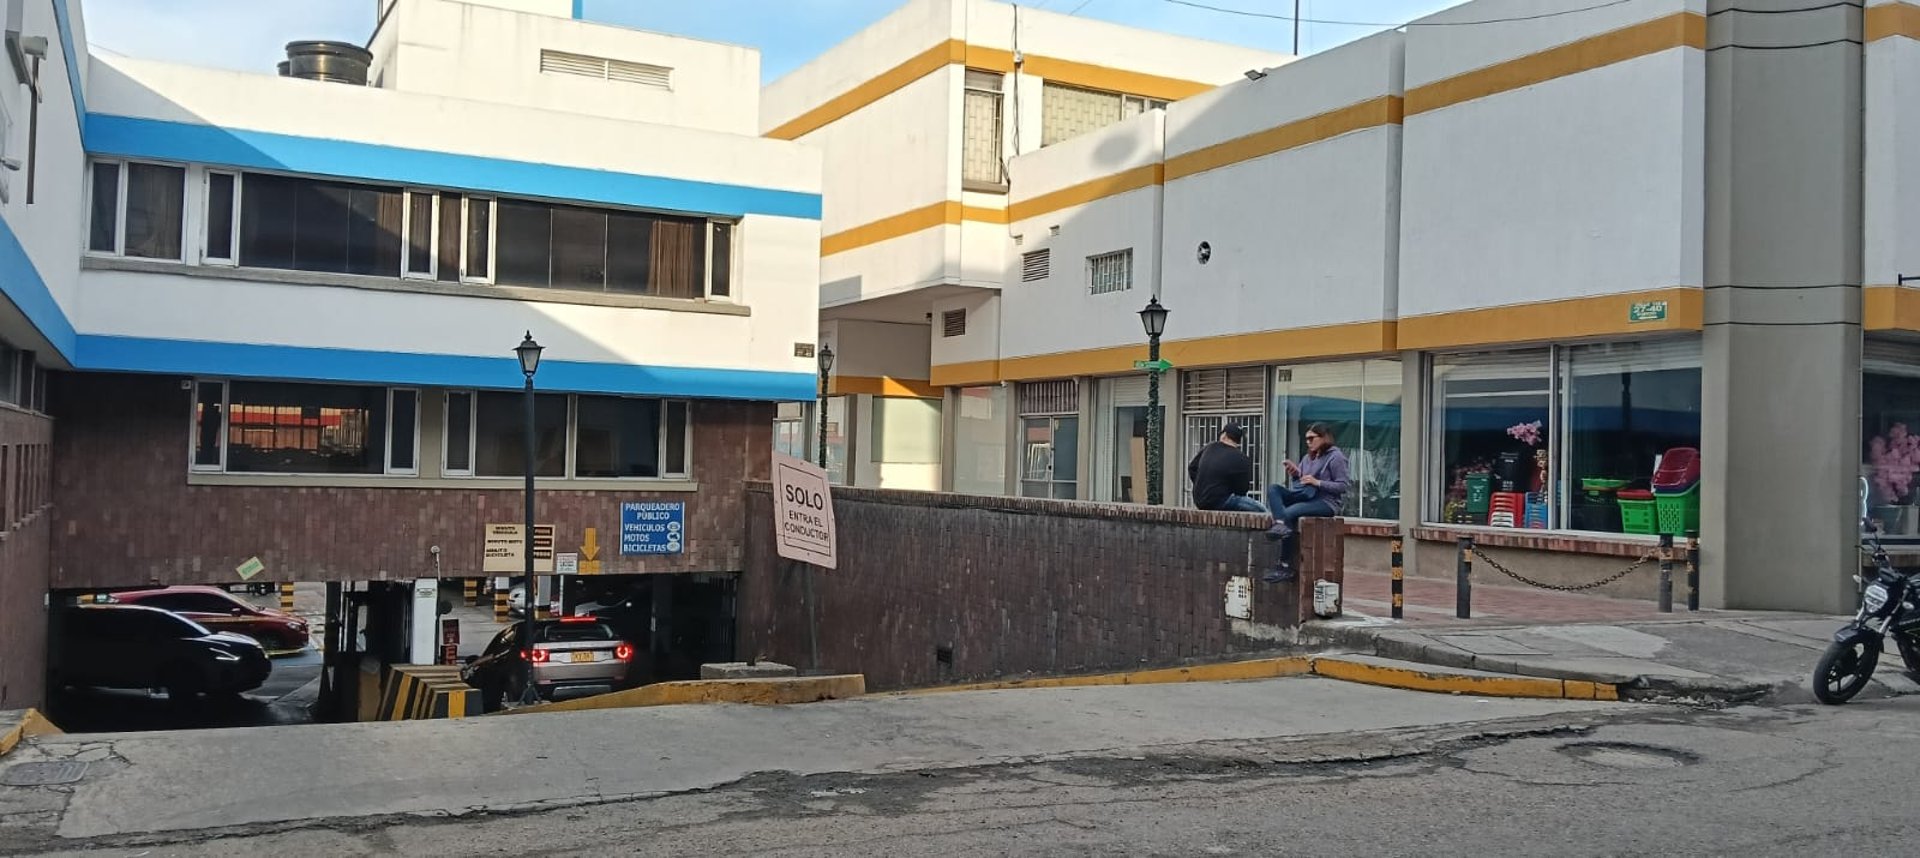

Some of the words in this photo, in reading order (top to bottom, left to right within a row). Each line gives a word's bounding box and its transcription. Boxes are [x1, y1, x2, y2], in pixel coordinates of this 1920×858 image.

[785, 484, 823, 510] SOLO
[625, 502, 680, 512] PARQUEADERO
[789, 510, 813, 524] ENTRA
[814, 518, 824, 528] EL
[623, 533, 650, 542] MOTOS
[784, 522, 829, 542] CONDUCTOR
[623, 543, 667, 553] BICICLETAS
